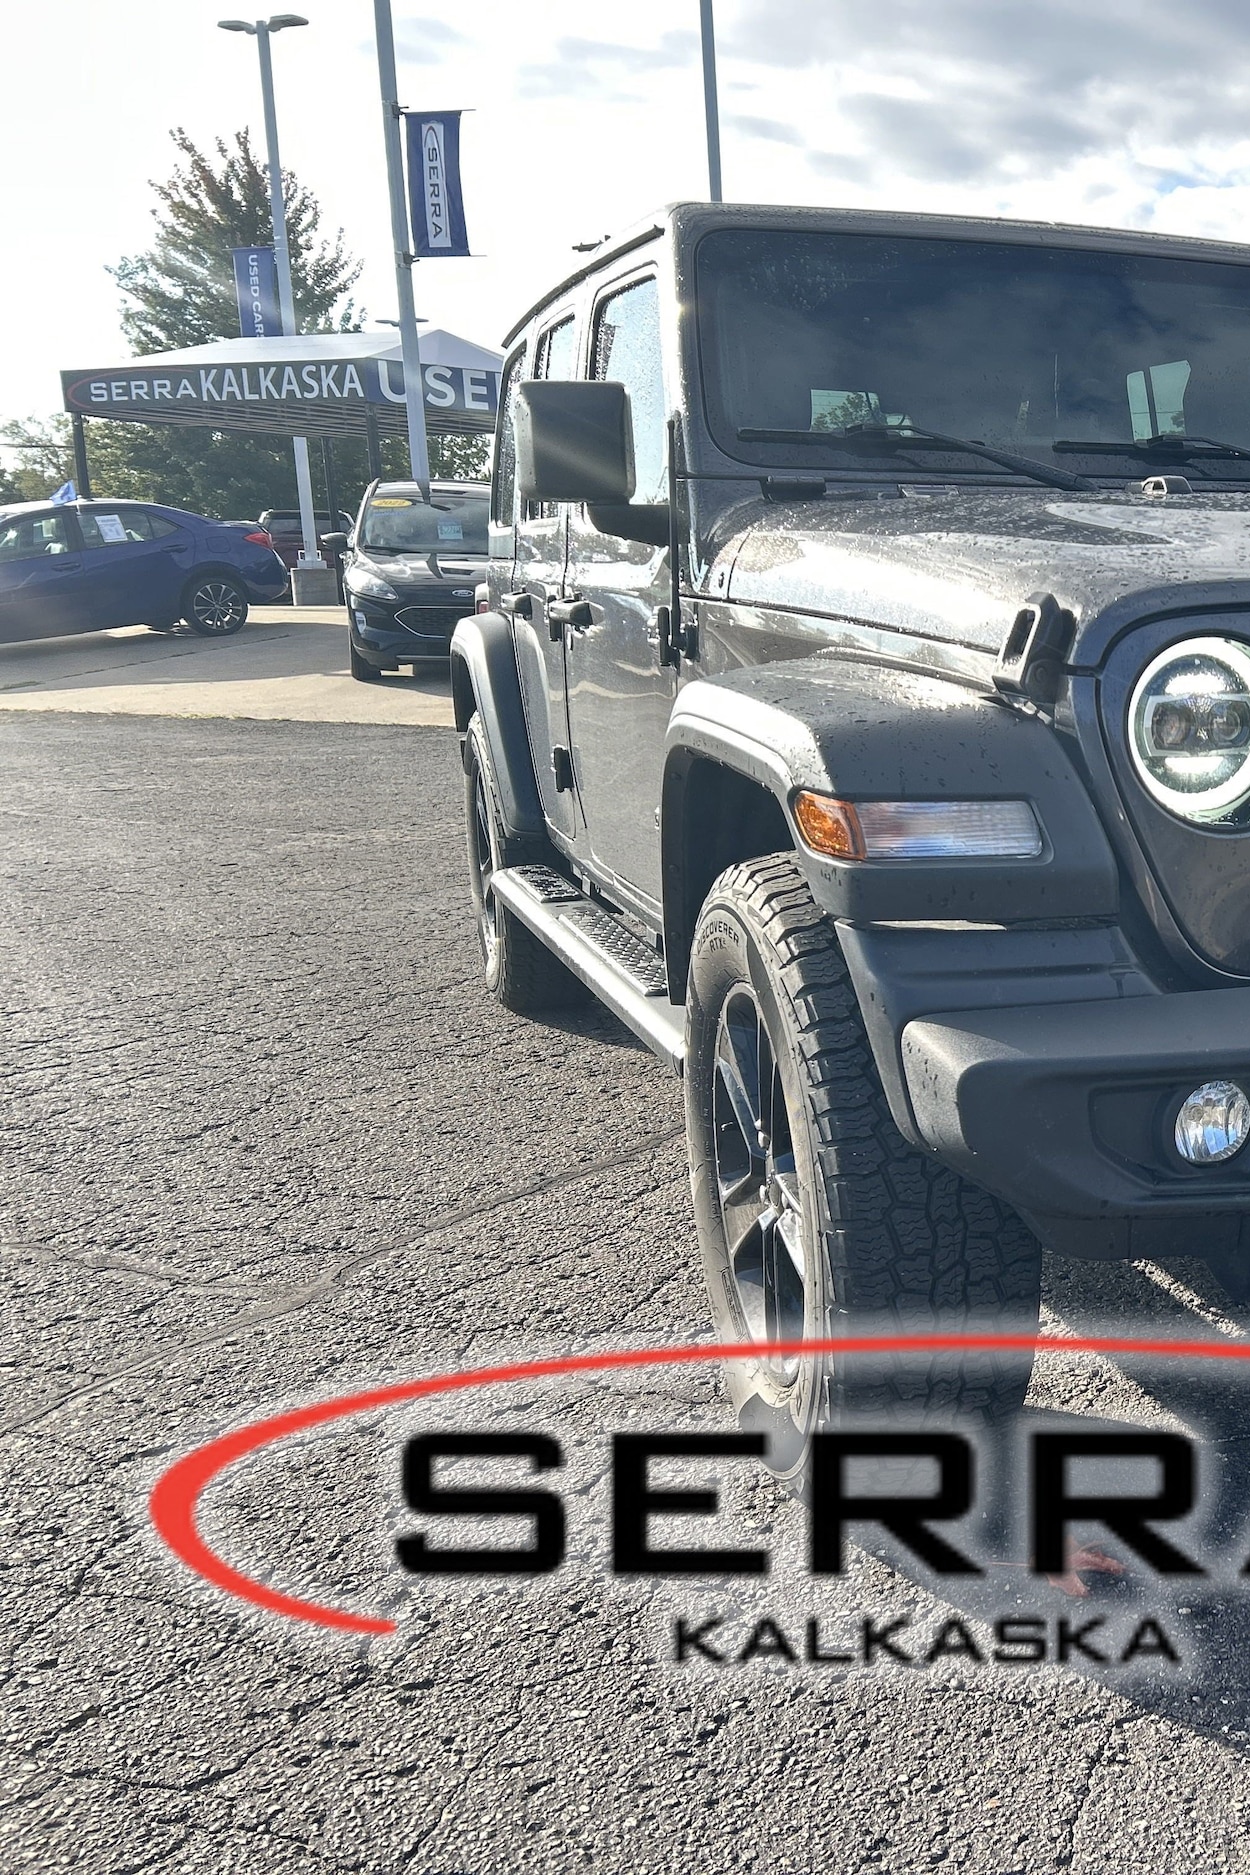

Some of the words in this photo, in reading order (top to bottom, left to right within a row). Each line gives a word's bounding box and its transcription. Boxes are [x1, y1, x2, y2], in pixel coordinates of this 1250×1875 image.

[427, 147, 443, 239] SERRA
[248, 254, 260, 297] USED
[252, 301, 265, 337] CAR
[90, 378, 198, 402] SERRA
[200, 363, 365, 402] KALKASKA
[378, 360, 502, 411] USE
[697, 920, 740, 956] DISCOVERER
